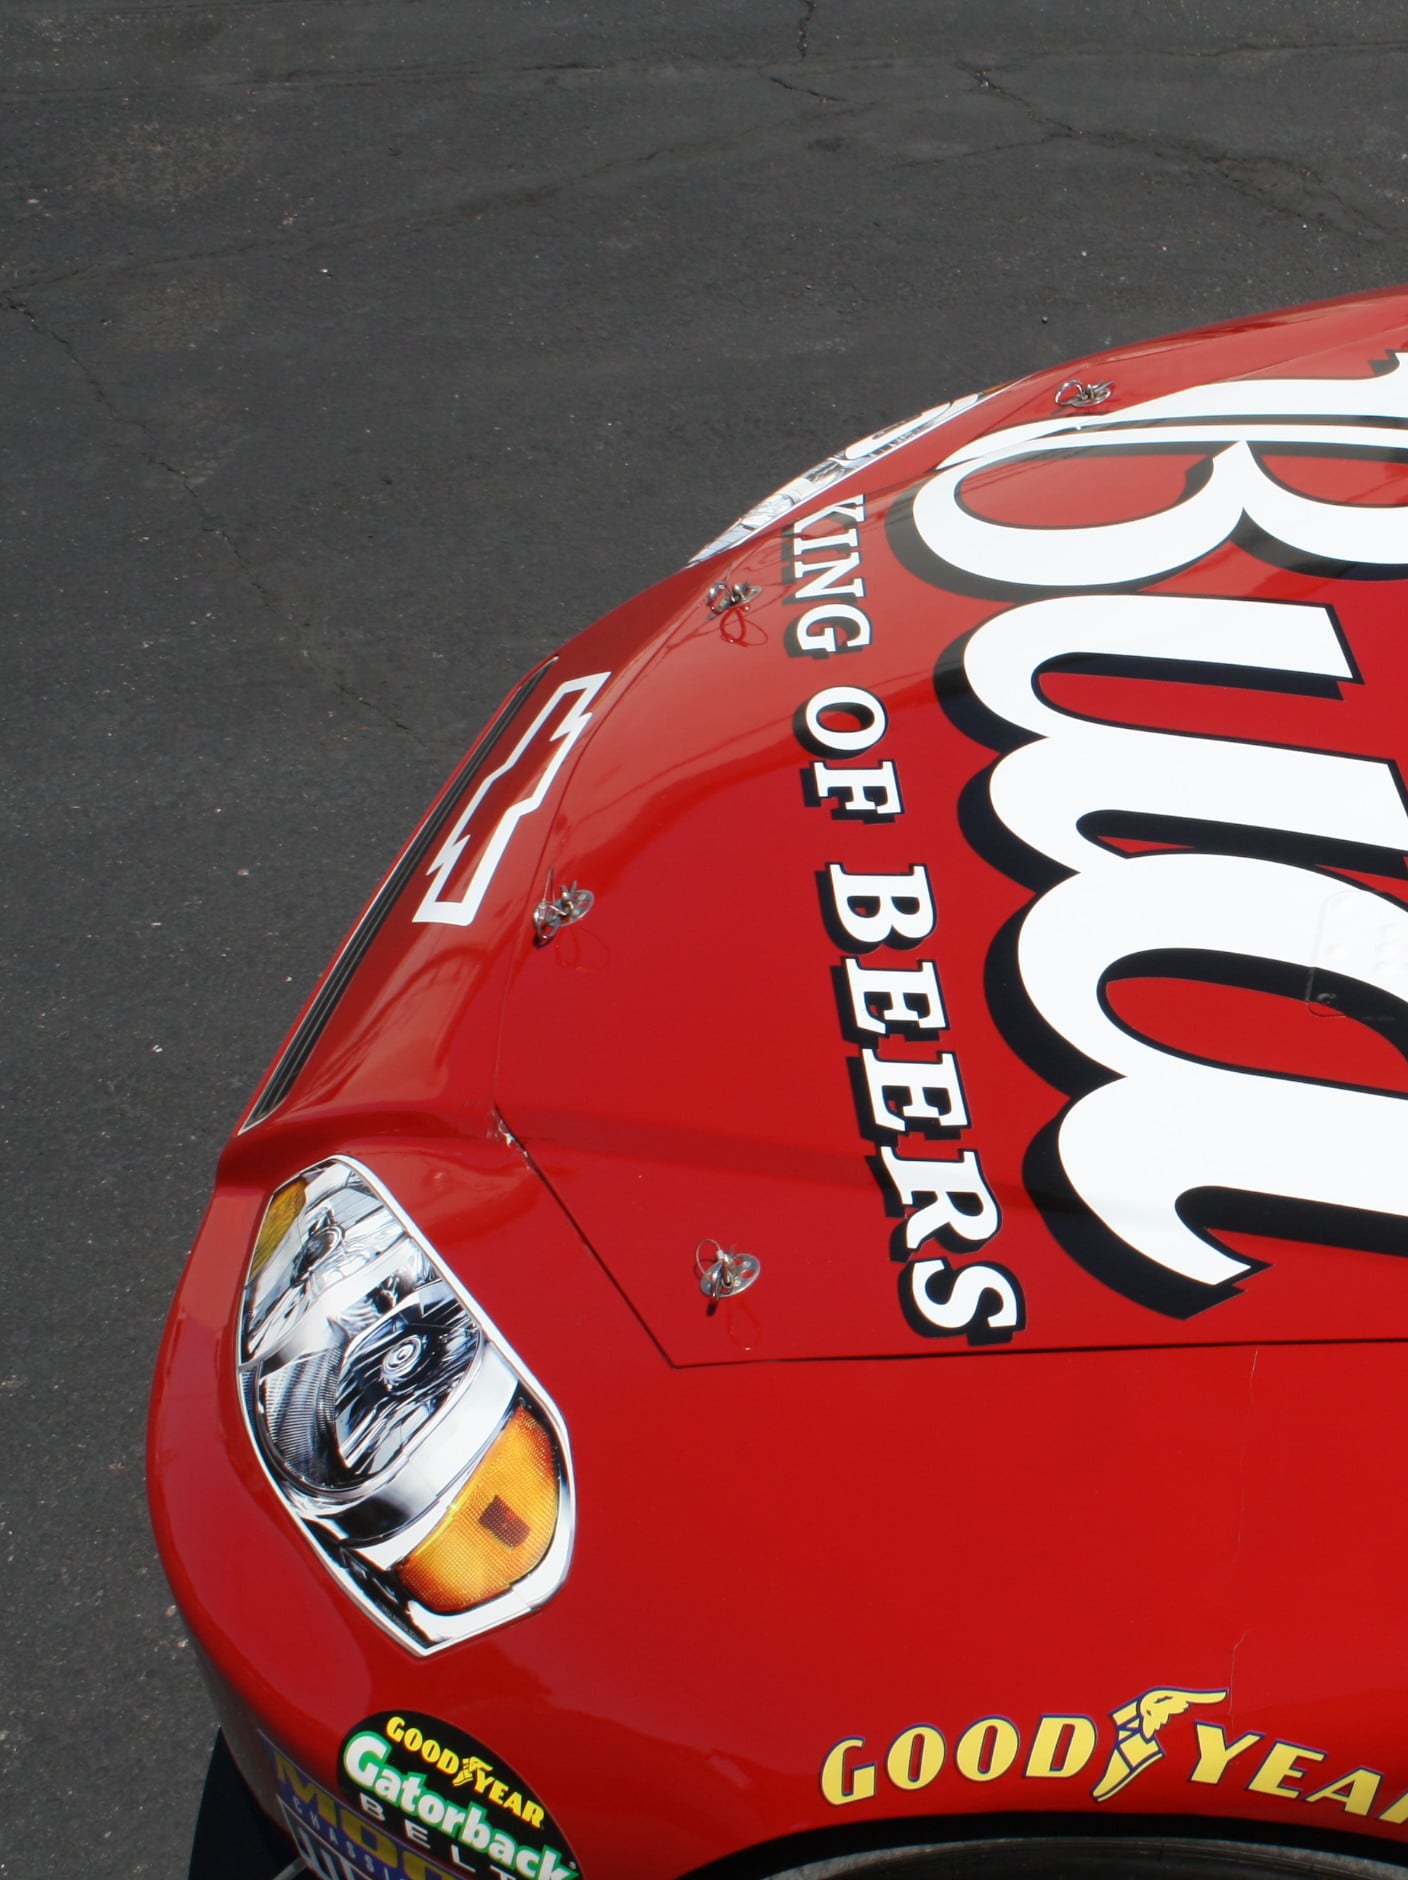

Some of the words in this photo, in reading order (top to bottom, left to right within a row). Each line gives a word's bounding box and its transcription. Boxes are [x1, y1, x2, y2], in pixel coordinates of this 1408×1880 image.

[788, 493, 873, 655] KING
[800, 685, 904, 820] OF
[823, 862, 1023, 1338] BEERS
[342, 1731, 579, 1880] Gatorback
[386, 1715, 460, 1776] GOOD
[470, 1769, 546, 1829] YEAR
[819, 1714, 1098, 1806] GOOD
[292, 1795, 407, 1880] CHASSI
